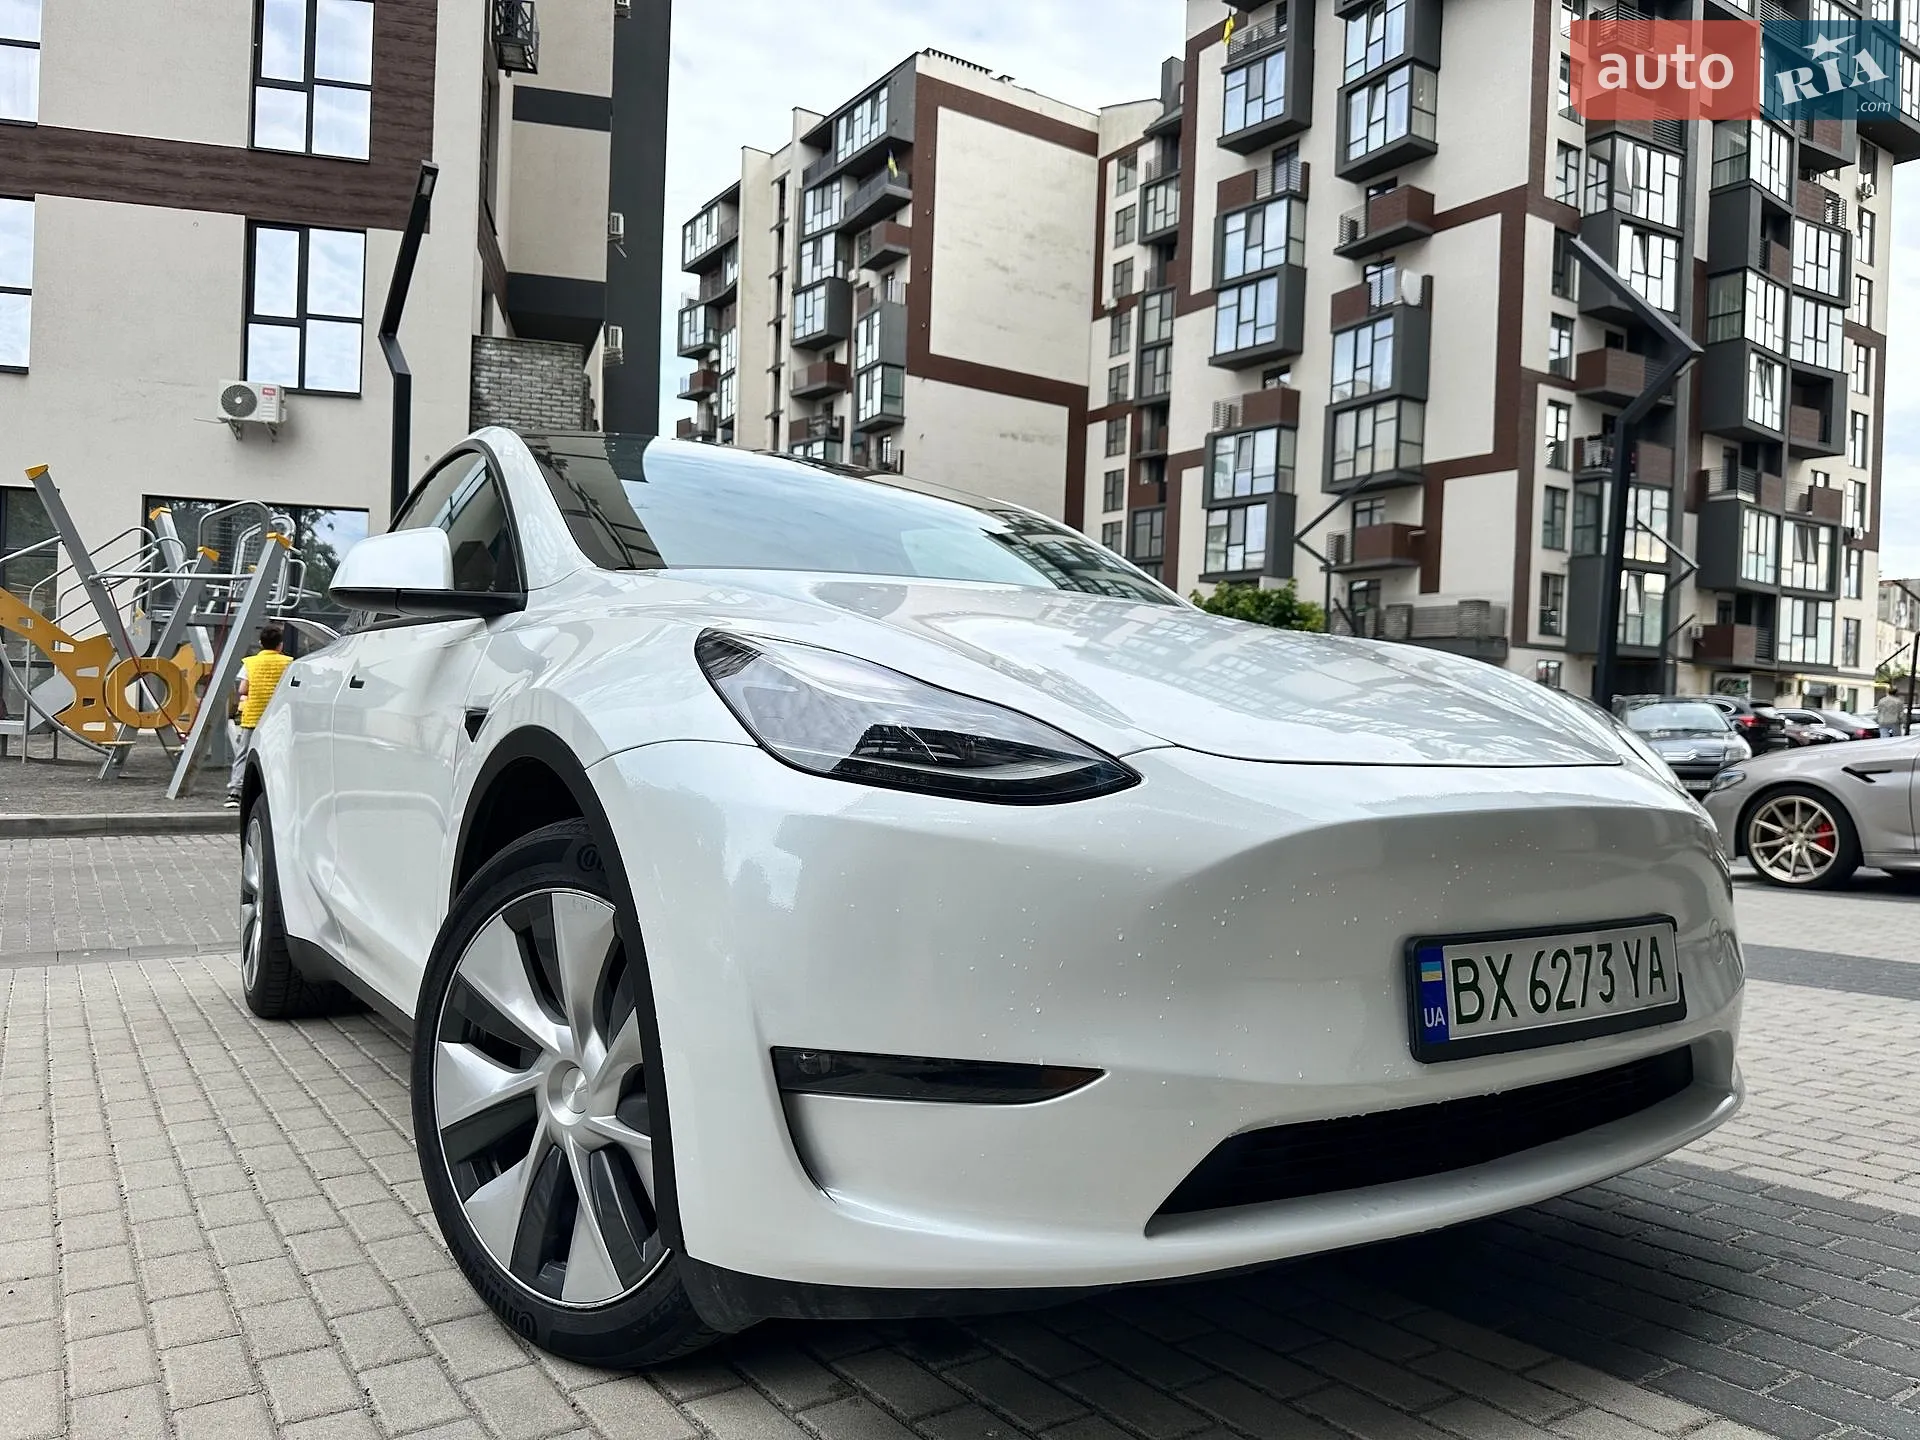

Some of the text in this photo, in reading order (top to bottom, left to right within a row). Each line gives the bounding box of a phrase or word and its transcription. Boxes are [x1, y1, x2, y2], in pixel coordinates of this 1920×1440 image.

[1451, 936, 1667, 1025] BX 6273 YA
[1424, 1006, 1446, 1028] UA
